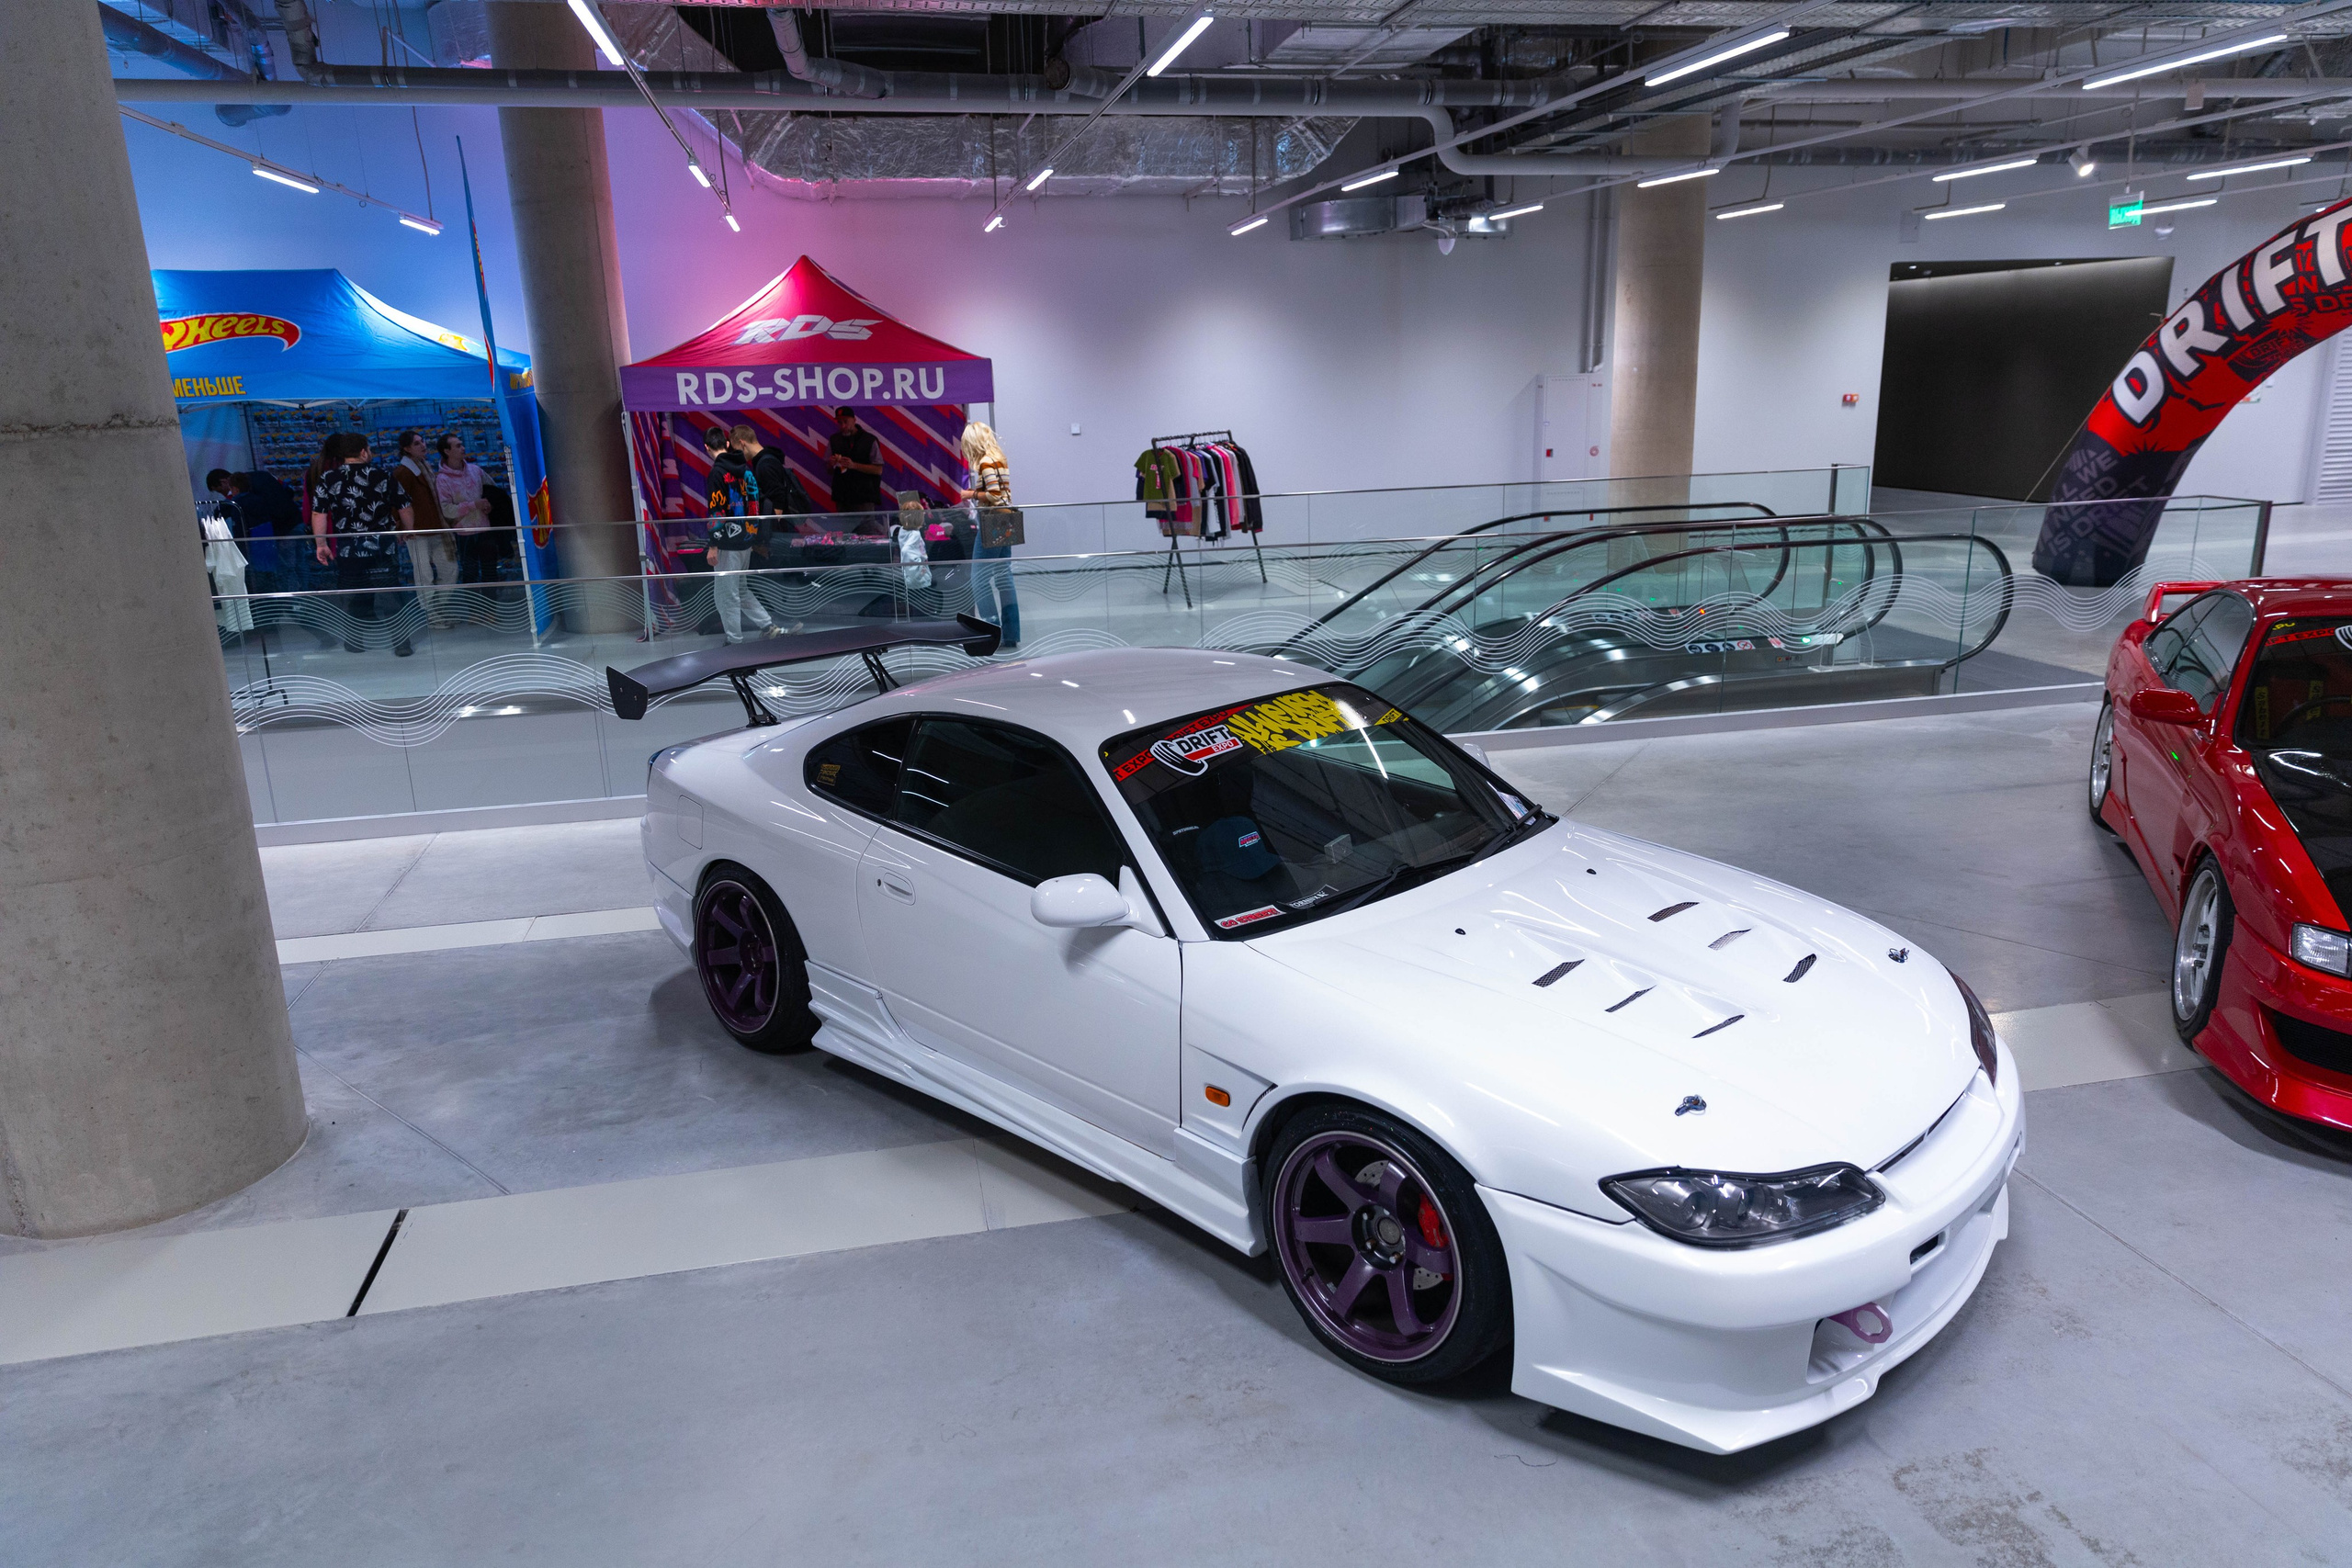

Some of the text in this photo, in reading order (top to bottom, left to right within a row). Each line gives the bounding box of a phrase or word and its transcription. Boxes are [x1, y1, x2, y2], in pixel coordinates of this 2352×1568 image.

[2112, 203, 2352, 424] DRIFT
[733, 315, 883, 344] RDS
[676, 367, 944, 405] RDS-SHOP.RU
[2075, 448, 2118, 484] WE
[2295, 628, 2335, 639] EXPO
[1168, 710, 1227, 740] RIFT EXPO
[1175, 727, 1229, 753] DRIFT
[1212, 740, 1234, 753] EXPO
[1124, 751, 1155, 773] EXPO
